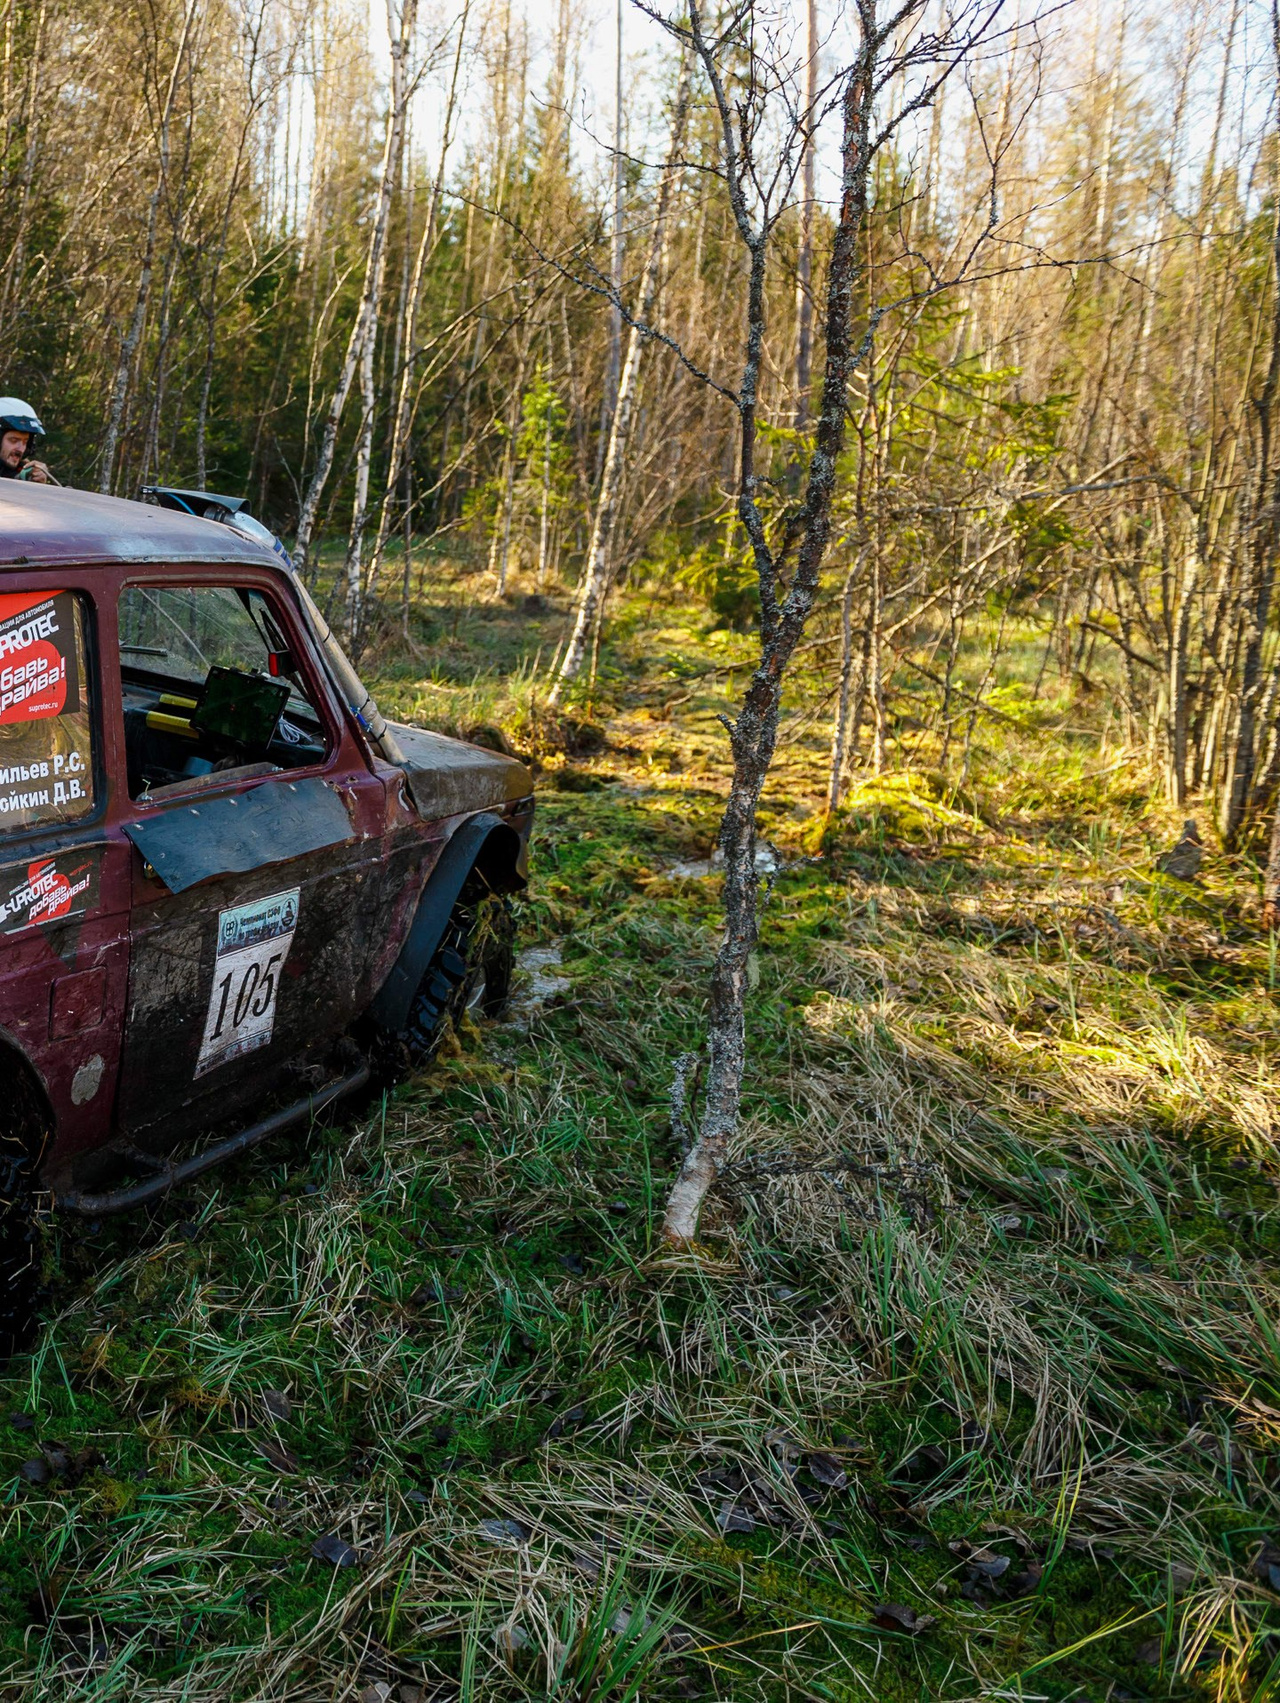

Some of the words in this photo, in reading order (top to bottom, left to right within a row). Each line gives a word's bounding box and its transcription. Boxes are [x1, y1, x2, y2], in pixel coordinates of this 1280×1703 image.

[28, 701, 59, 713] suprotec.ru
[53, 752, 85, 775] Р.С.
[53, 779, 86, 807] Д.В.
[209, 953, 282, 1042] 105
